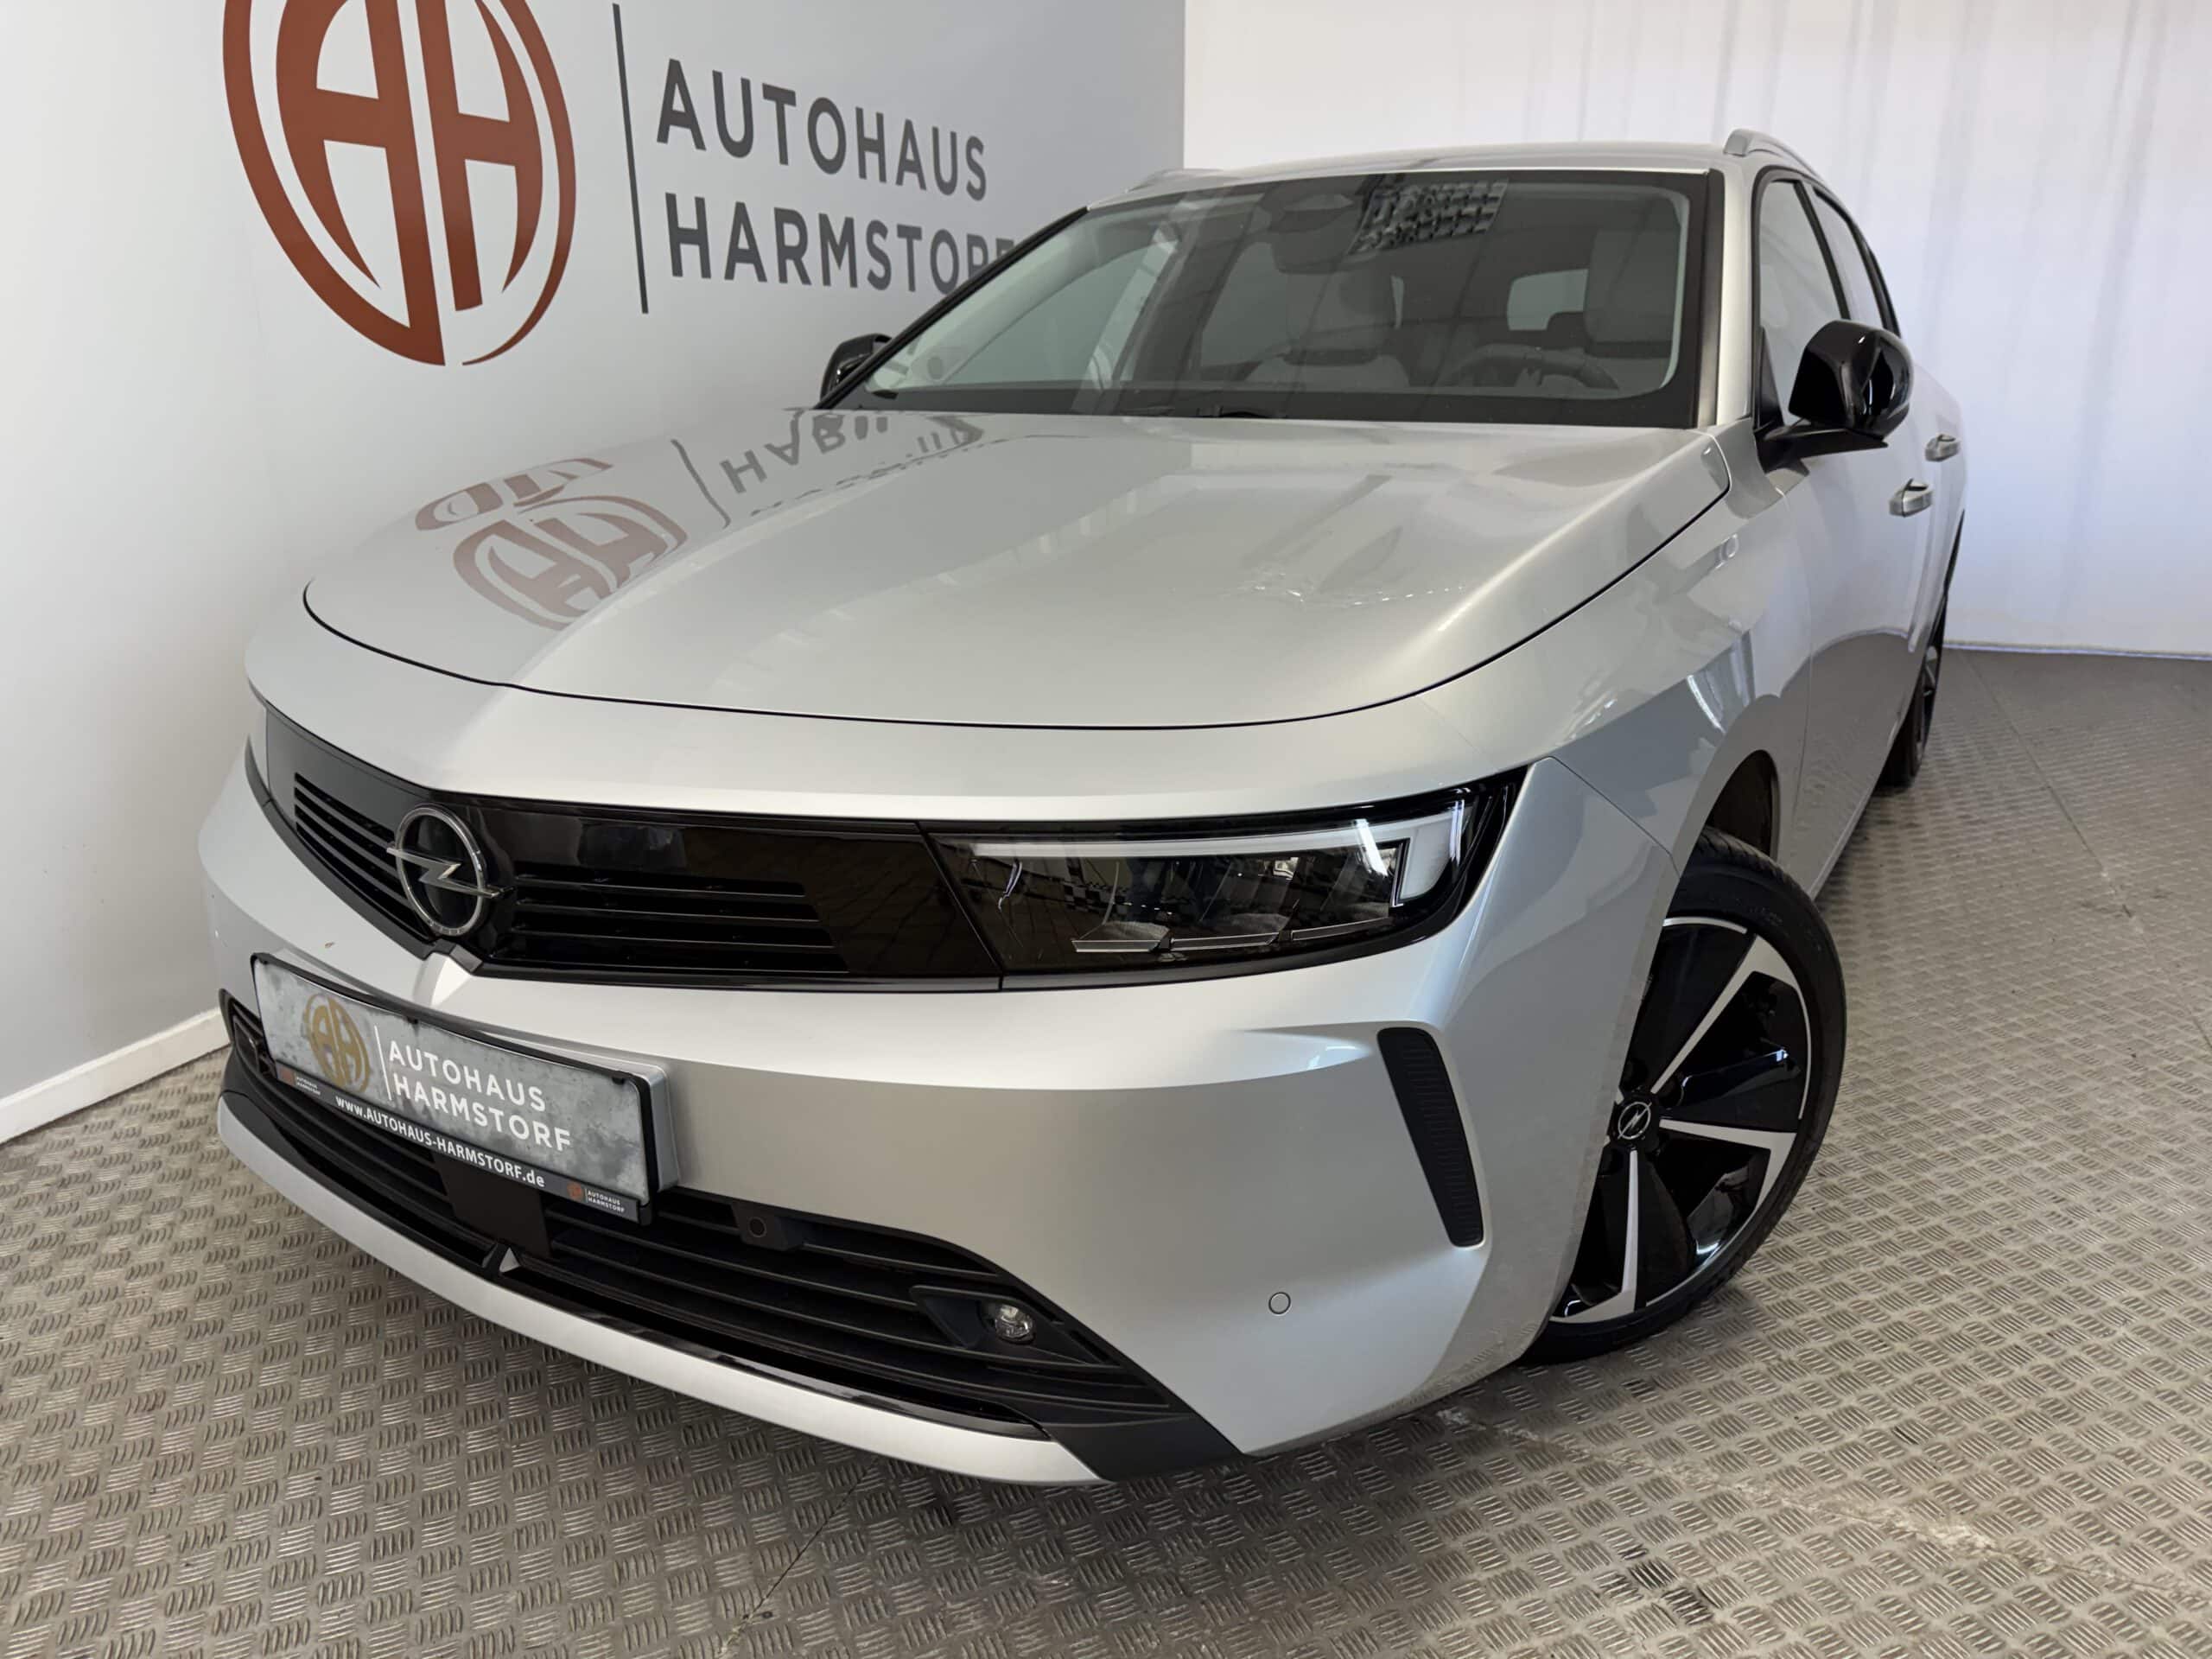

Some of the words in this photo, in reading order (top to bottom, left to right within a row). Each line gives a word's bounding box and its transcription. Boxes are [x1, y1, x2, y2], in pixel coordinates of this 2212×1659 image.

[657, 59, 988, 201] AUTOHAUS
[389, 1040, 546, 1112] AUTOHAUS
[393, 1073, 572, 1151] HARMSTORF
[335, 1096, 545, 1187] www.AUTOHAUS-HARMSTORF.de
[588, 1190, 620, 1205] AUTOHAUS
[588, 1196, 626, 1213] HARMSTORF
